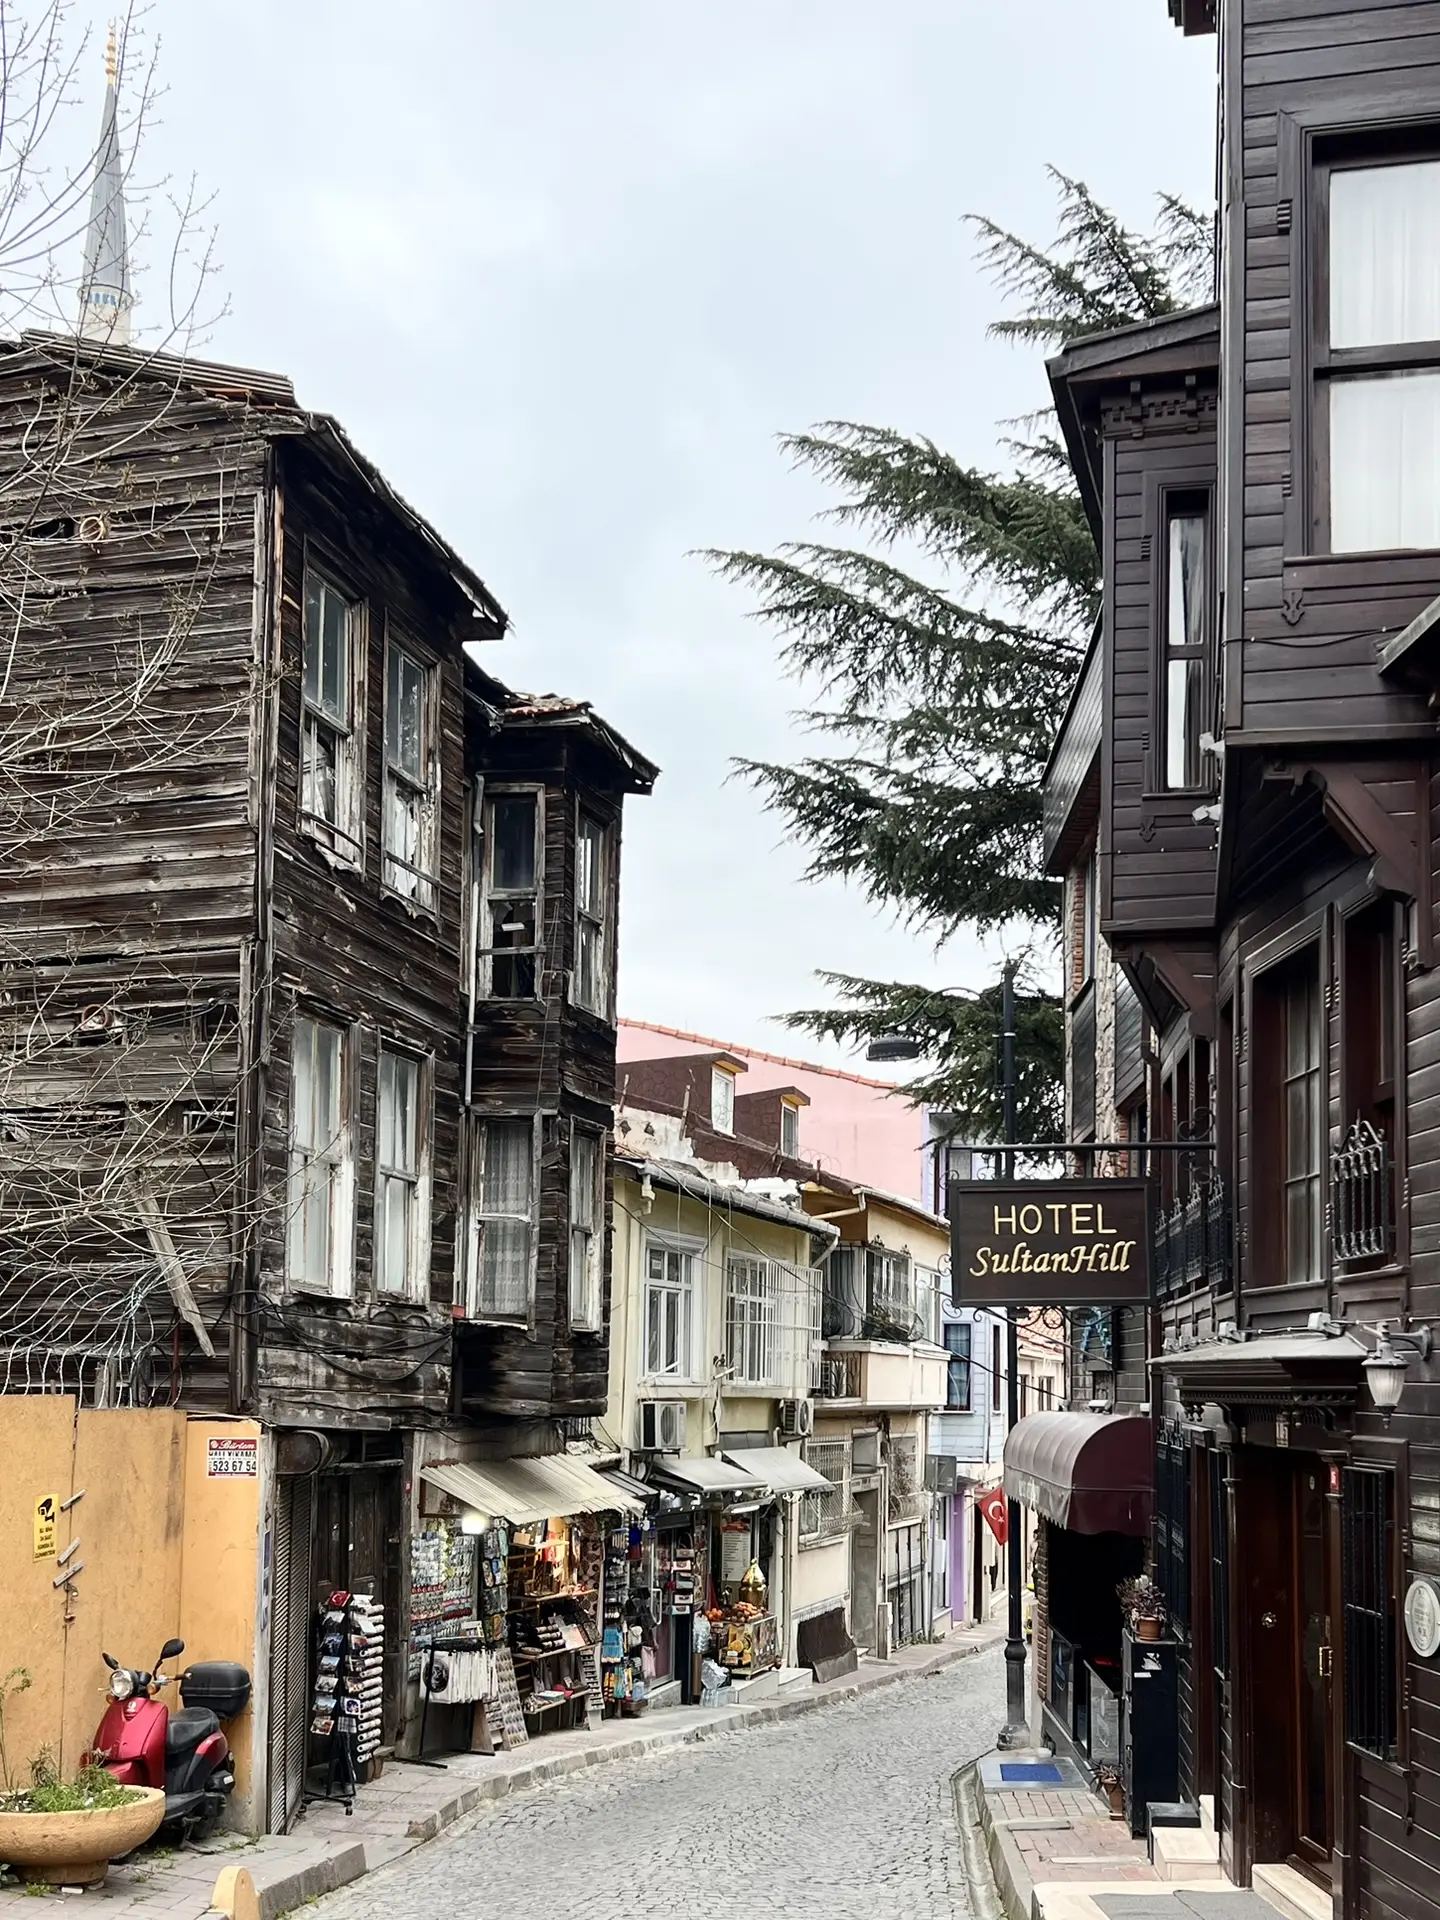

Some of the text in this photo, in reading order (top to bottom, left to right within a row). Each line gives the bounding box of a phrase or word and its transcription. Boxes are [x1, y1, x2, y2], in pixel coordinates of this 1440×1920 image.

[994, 1203, 1117, 1235] HOTEL
[213, 1460, 229, 1471] 523
[232, 1460, 242, 1471] 67
[246, 1460, 256, 1471] 54
